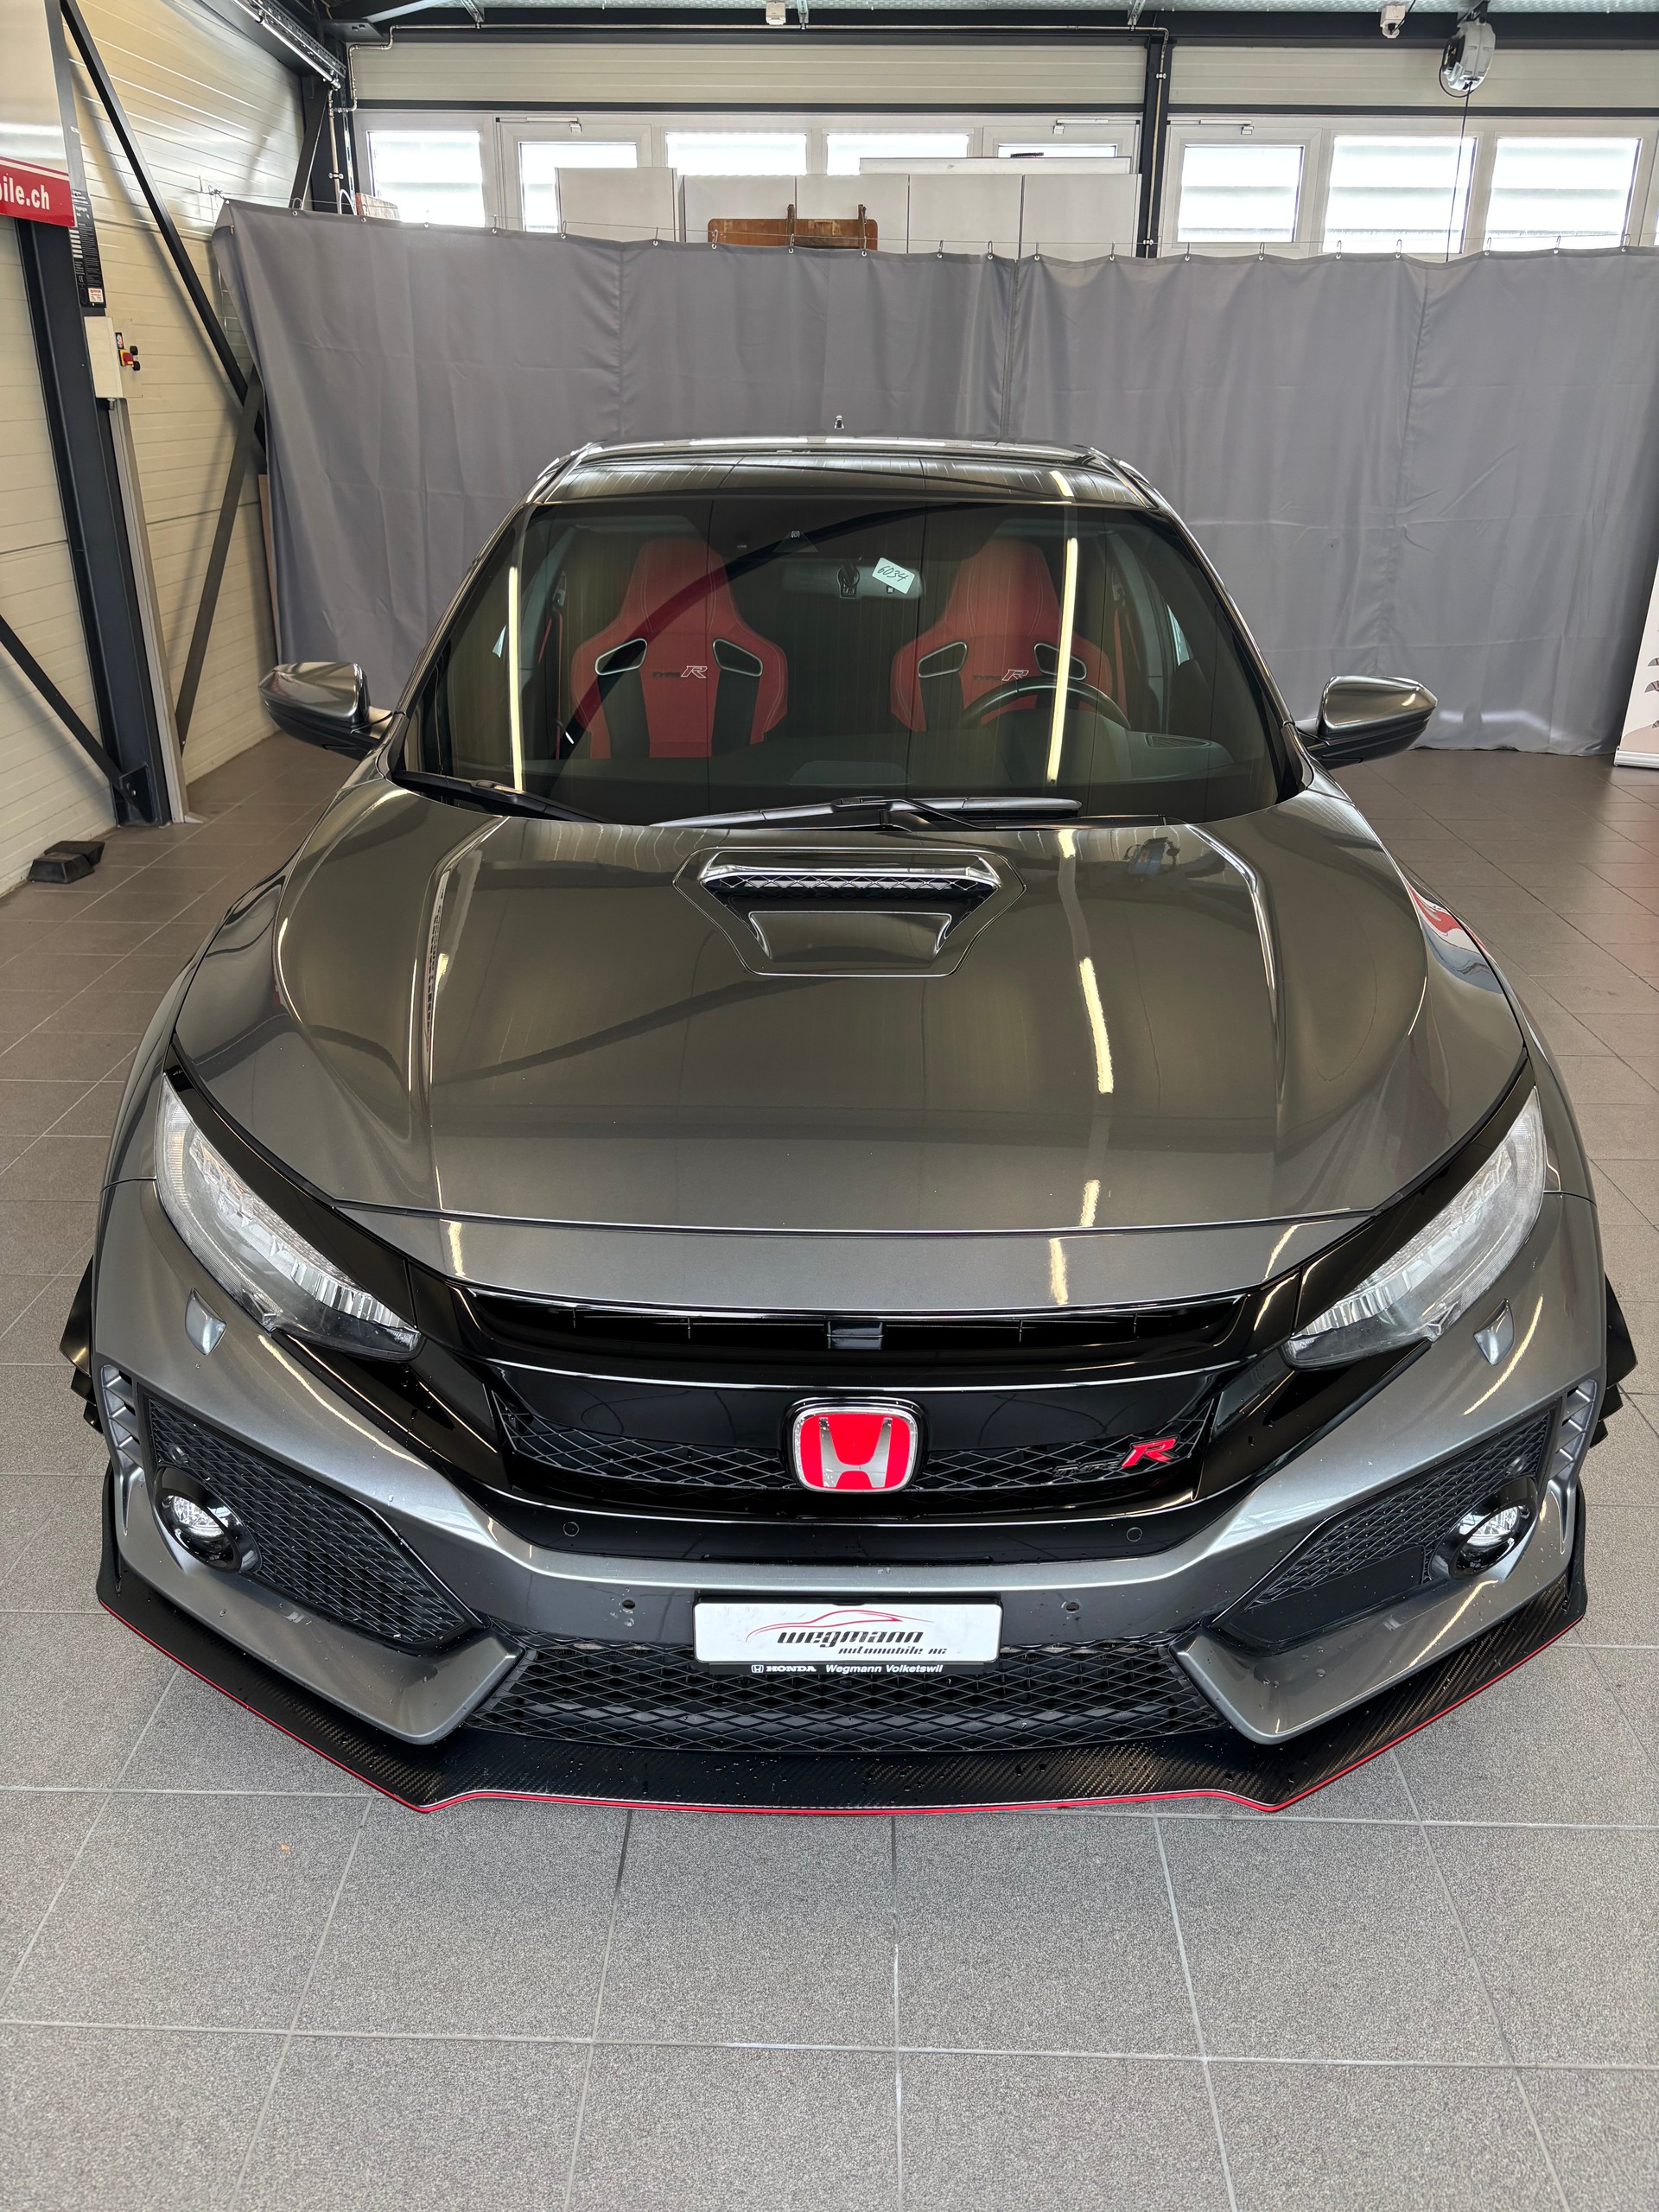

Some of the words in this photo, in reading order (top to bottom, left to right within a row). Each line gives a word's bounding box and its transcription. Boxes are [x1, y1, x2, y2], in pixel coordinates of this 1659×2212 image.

[0, 175, 50, 210] ile.ch
[877, 565, 909, 582] 6034
[680, 665, 708, 678] R
[1121, 1436, 1177, 1468] R
[777, 1630, 924, 1648] wegmann
[825, 1664, 882, 1675] Wegmann
[886, 1664, 944, 1673] Volketswil
